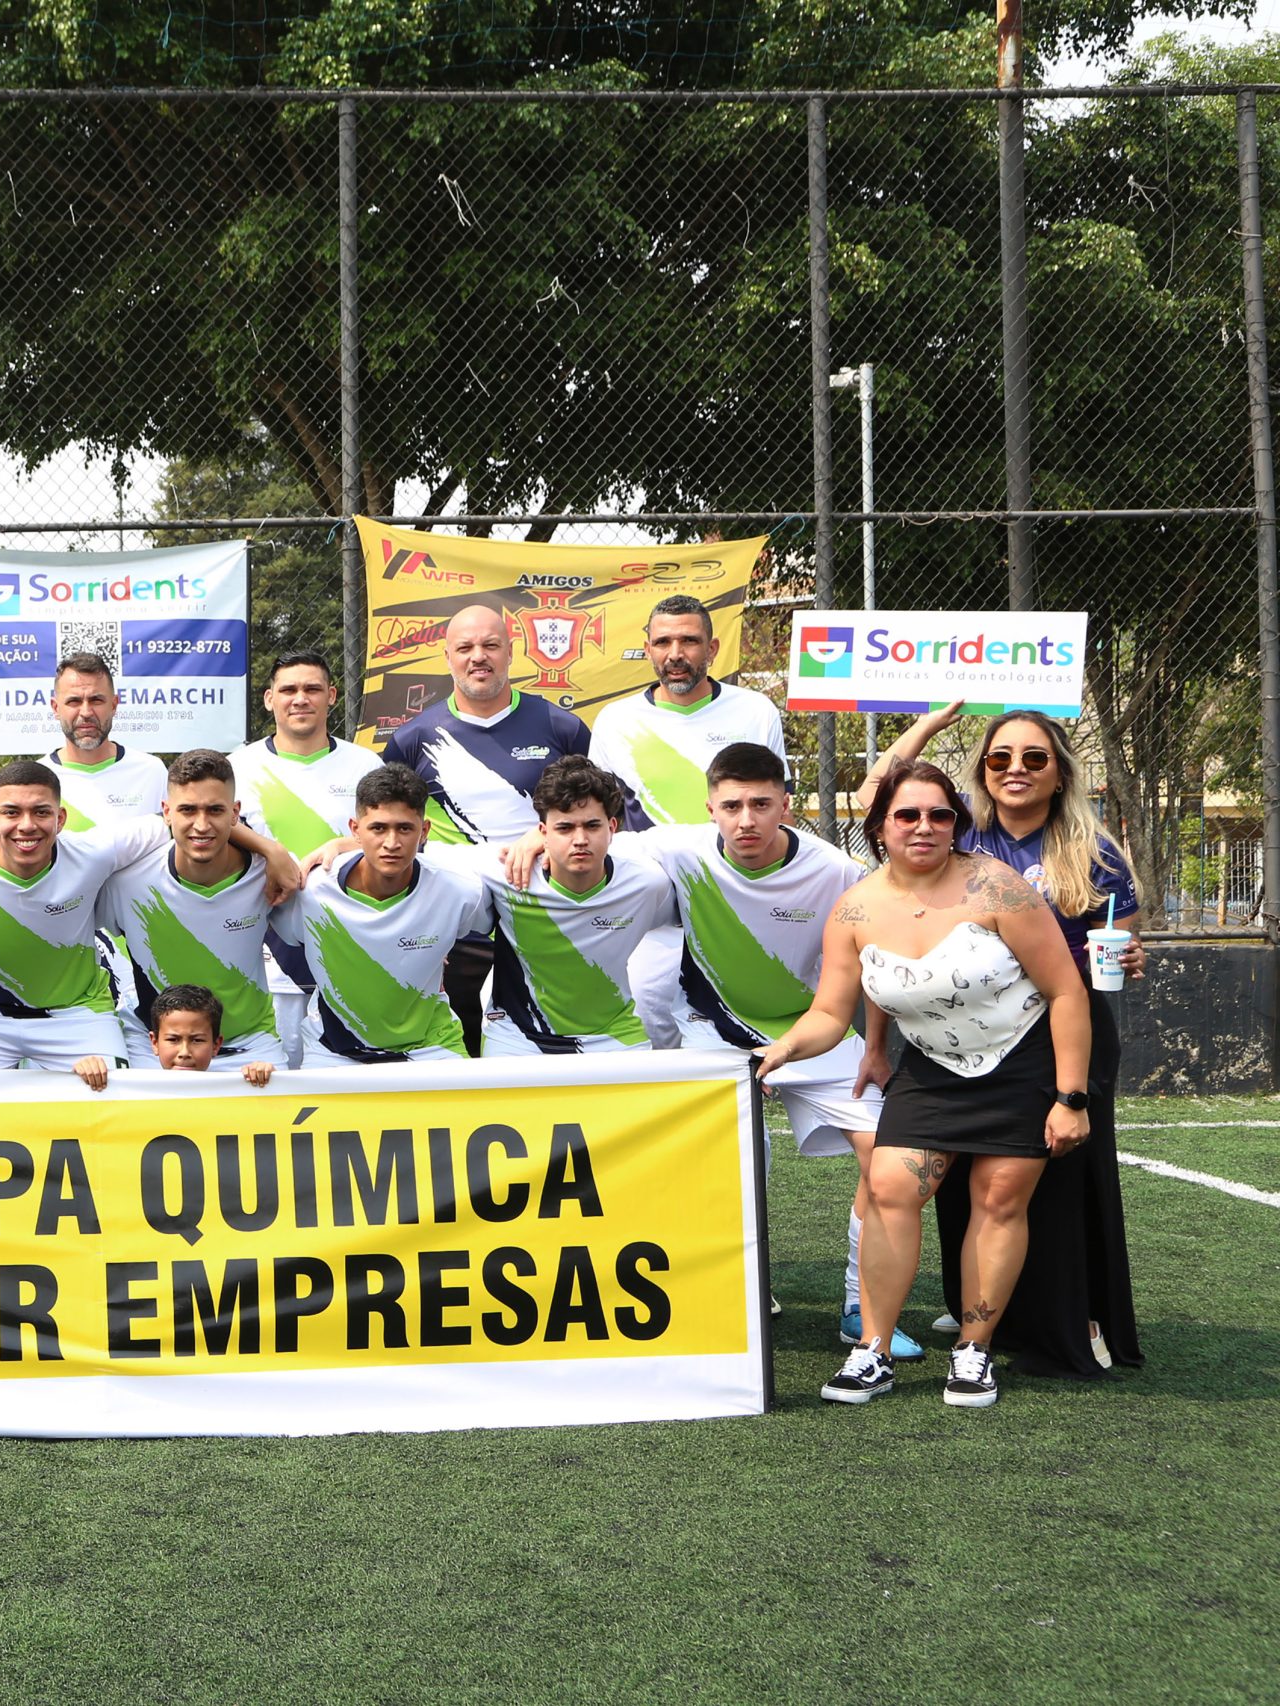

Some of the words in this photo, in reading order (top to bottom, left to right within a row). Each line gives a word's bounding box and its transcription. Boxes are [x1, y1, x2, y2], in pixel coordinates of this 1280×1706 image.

[421, 568, 475, 586] WFG
[516, 573, 593, 588] AMIGOS
[12, 633, 37, 645] SUA
[126, 640, 143, 653] 11
[147, 640, 231, 653] 93232-8778
[945, 671, 1072, 684] Odontológicas
[117, 688, 224, 705] EMARCHI
[167, 710, 194, 720] 1791
[140, 1106, 605, 1247] QUÍMICA
[105, 1241, 672, 1359] EMPRESAS
